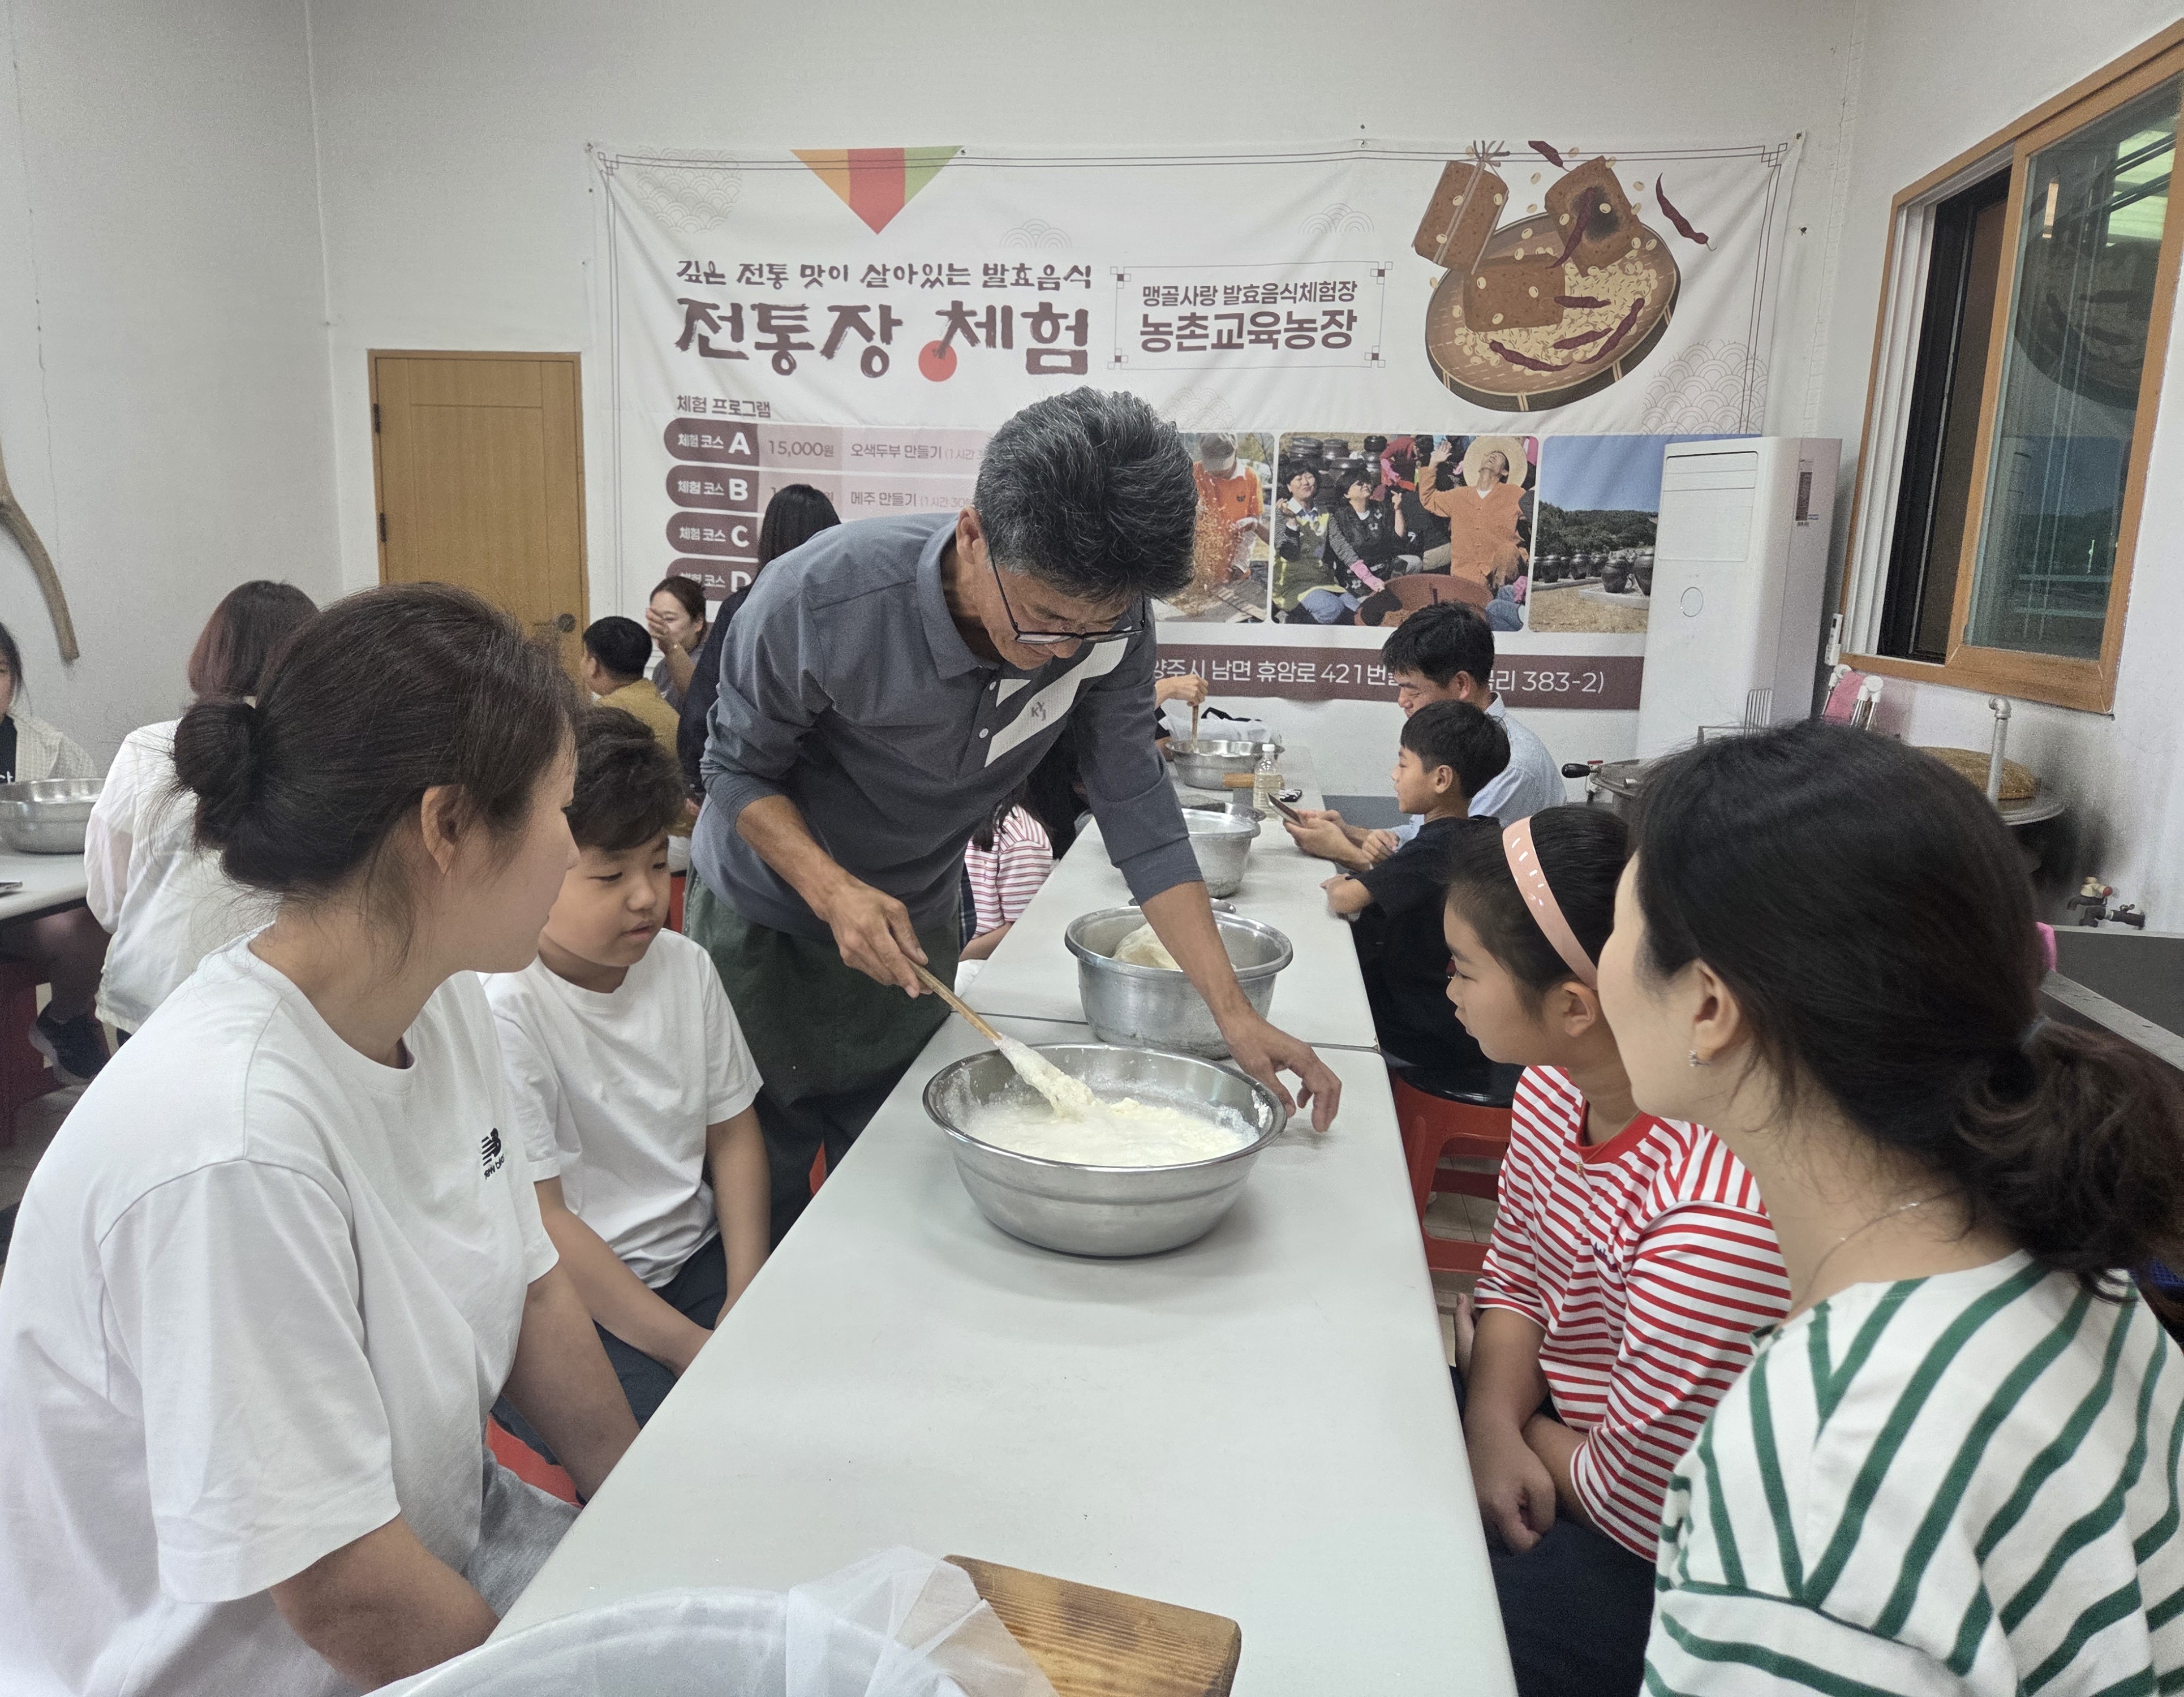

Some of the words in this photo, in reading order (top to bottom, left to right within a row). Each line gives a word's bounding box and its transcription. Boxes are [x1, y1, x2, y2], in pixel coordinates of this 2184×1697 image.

[677, 260, 726, 285] 깊은
[736, 263, 789, 290] 전통
[800, 264, 849, 289] 맛이
[860, 263, 970, 289] 살아있는
[982, 263, 1091, 291] 발효음식
[1142, 285, 1218, 307] 맹골사랑
[1223, 281, 1358, 305] 발효음식체험장
[674, 298, 904, 378] 전통장
[931, 300, 1089, 376] 체험
[1140, 309, 1358, 353] 농촌교육농장
[677, 395, 707, 414] 체험
[711, 398, 771, 419] 프로그램
[678, 434, 699, 447] 체험
[701, 434, 724, 449] 코스
[728, 432, 751, 455] A
[768, 440, 834, 458] 15,000원
[850, 443, 901, 458] 오색두부
[904, 445, 941, 459] 만들기
[678, 481, 701, 494] 체험
[703, 482, 724, 496] 코스
[729, 479, 748, 501] B
[850, 492, 876, 506] 메주
[879, 492, 917, 507] 만들기
[680, 527, 700, 541] 체험
[703, 528, 726, 542] 코스
[731, 525, 750, 548] C
[704, 574, 726, 588] 코스
[731, 570, 752, 592] D
[1212, 660, 1251, 680] 남면
[1257, 661, 1316, 683] 휴암로
[1521, 671, 1604, 694] 383-2)
